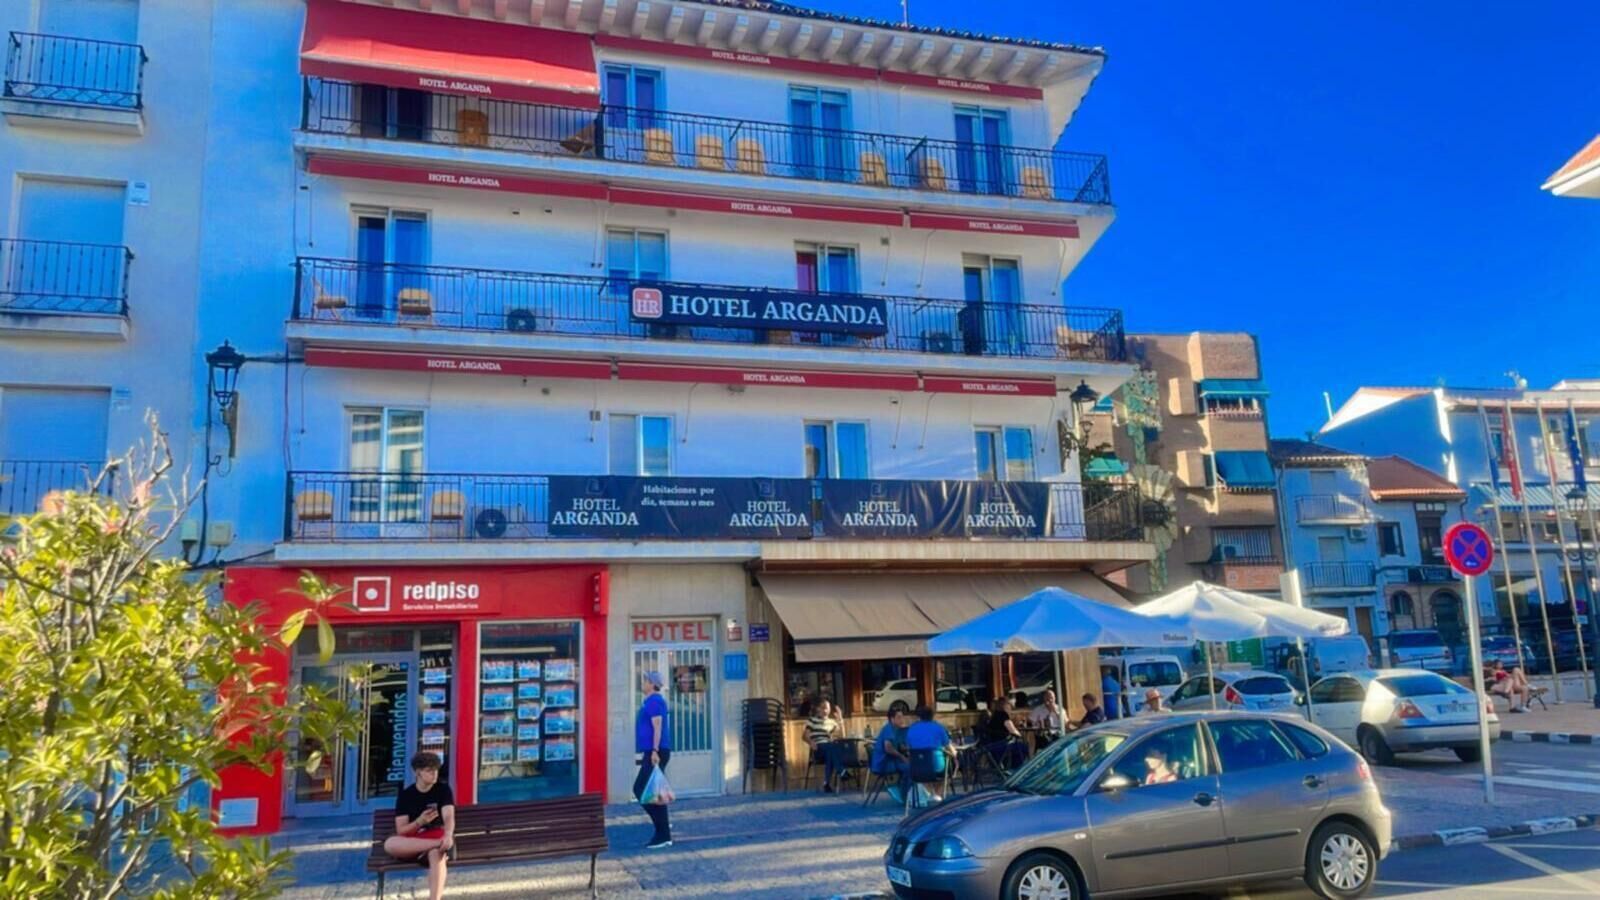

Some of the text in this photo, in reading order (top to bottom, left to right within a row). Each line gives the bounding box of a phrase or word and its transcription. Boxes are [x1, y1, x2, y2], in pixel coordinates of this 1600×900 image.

[711, 50, 735, 60] HOTEL
[419, 78, 492, 94] HOTEL ARGANDA
[428, 173, 500, 187] HOTEL ARGANDA
[731, 202, 793, 214] HOTEL ARGANDA
[669, 294, 884, 326] HOTEL ARGANDA
[427, 360, 502, 371] HOTEL ARGANDA
[743, 373, 806, 384] HOTEL ARGANDA
[643, 485, 715, 497] Habitaciones por
[572, 498, 621, 511] HOTEL
[747, 501, 791, 513] HOTEL
[858, 500, 900, 513] HOTEL
[980, 502, 1020, 514] HOTEL
[551, 511, 640, 526] ARGANDA
[728, 513, 809, 527] ARGANDA
[842, 513, 918, 527] ARGANDA
[965, 514, 1037, 528] ARGANDA
[403, 581, 480, 602] redpiso
[634, 622, 711, 641] HOTEL
[386, 692, 408, 782] Bienvenidos
